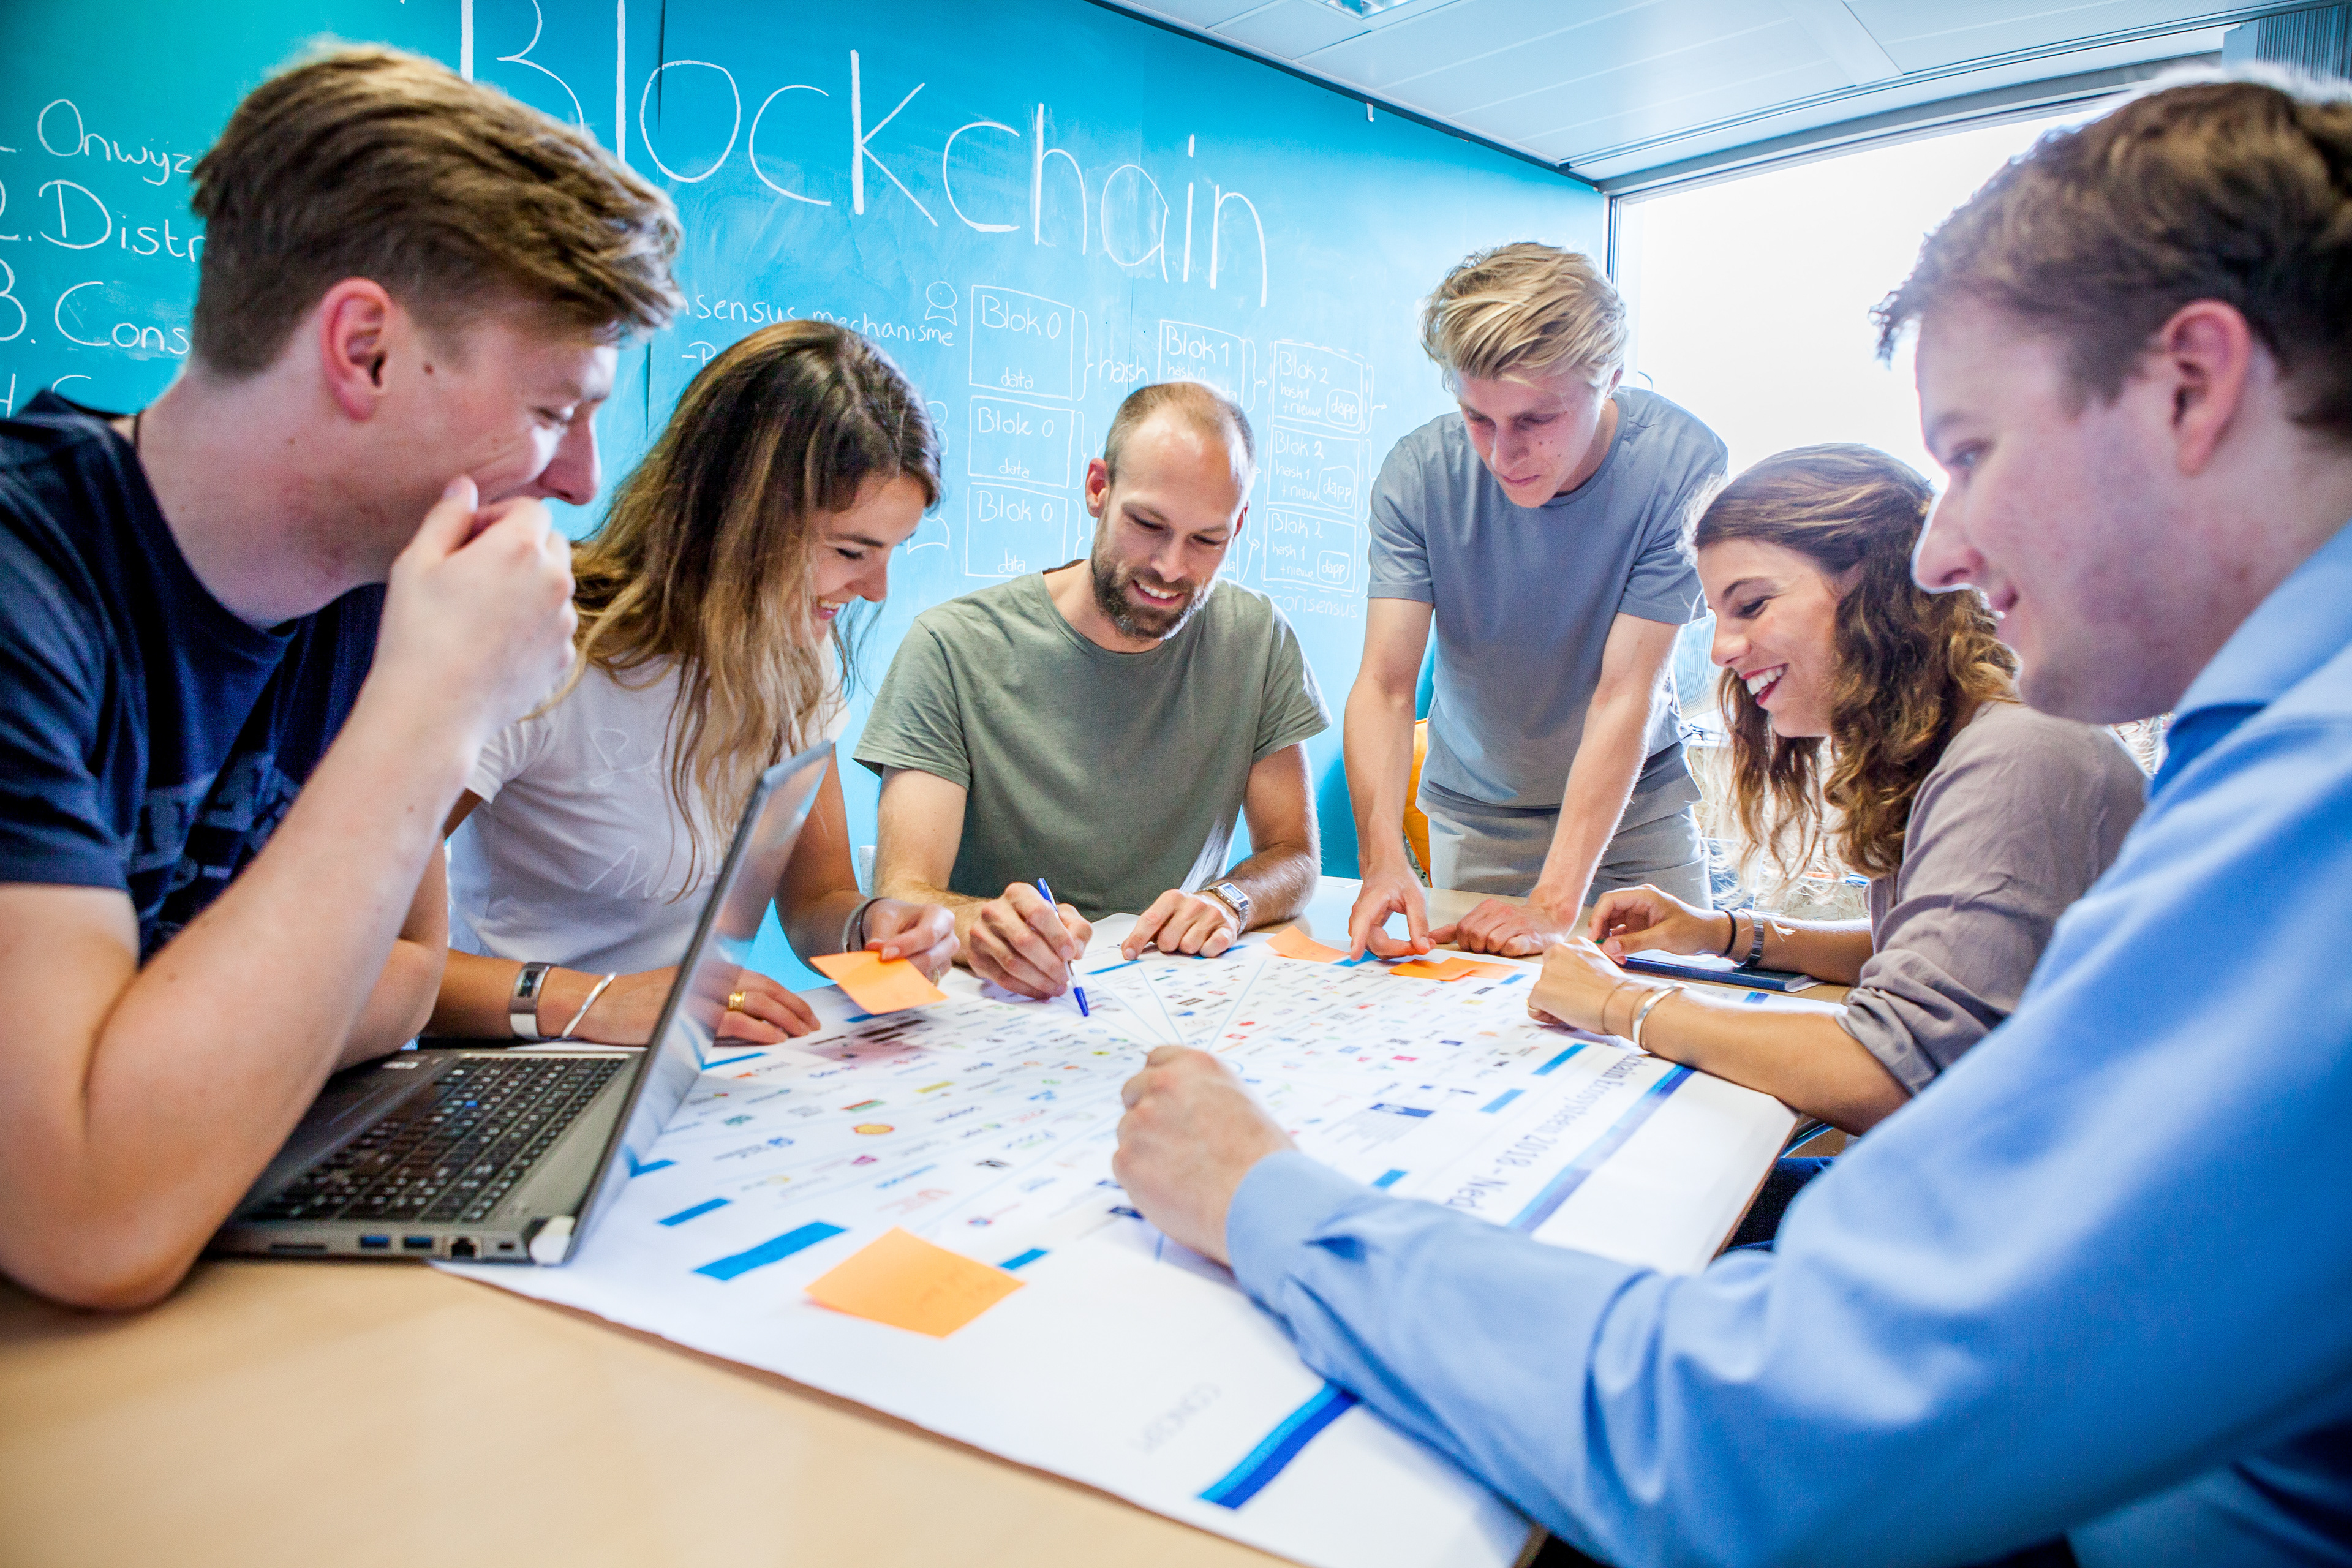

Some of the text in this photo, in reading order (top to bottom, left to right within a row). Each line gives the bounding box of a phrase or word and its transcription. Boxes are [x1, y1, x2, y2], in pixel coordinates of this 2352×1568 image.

[461, 0, 1264, 307] Blockchain
[55, 281, 190, 355] Cons
[981, 295, 1041, 336] Blok
[1166, 325, 1229, 367] Blok 1
[1001, 367, 1033, 390] data
[1099, 348, 1149, 385] hash
[1167, 361, 1194, 378] hash
[1280, 351, 1329, 385] Blok 2
[978, 407, 1033, 435] Blok
[1331, 396, 1357, 421] dapp
[1275, 431, 1325, 459] Blok 2
[998, 458, 1030, 478] data
[1275, 459, 1310, 481] hash 1
[1323, 477, 1352, 503] dapp
[976, 491, 1031, 522] Blok
[1271, 513, 1324, 538] Blok 2
[998, 547, 1026, 573] data
[1272, 541, 1305, 561] hash 1
[1321, 559, 1346, 580] dapp
[1494, 1134, 1558, 1167] 2018
